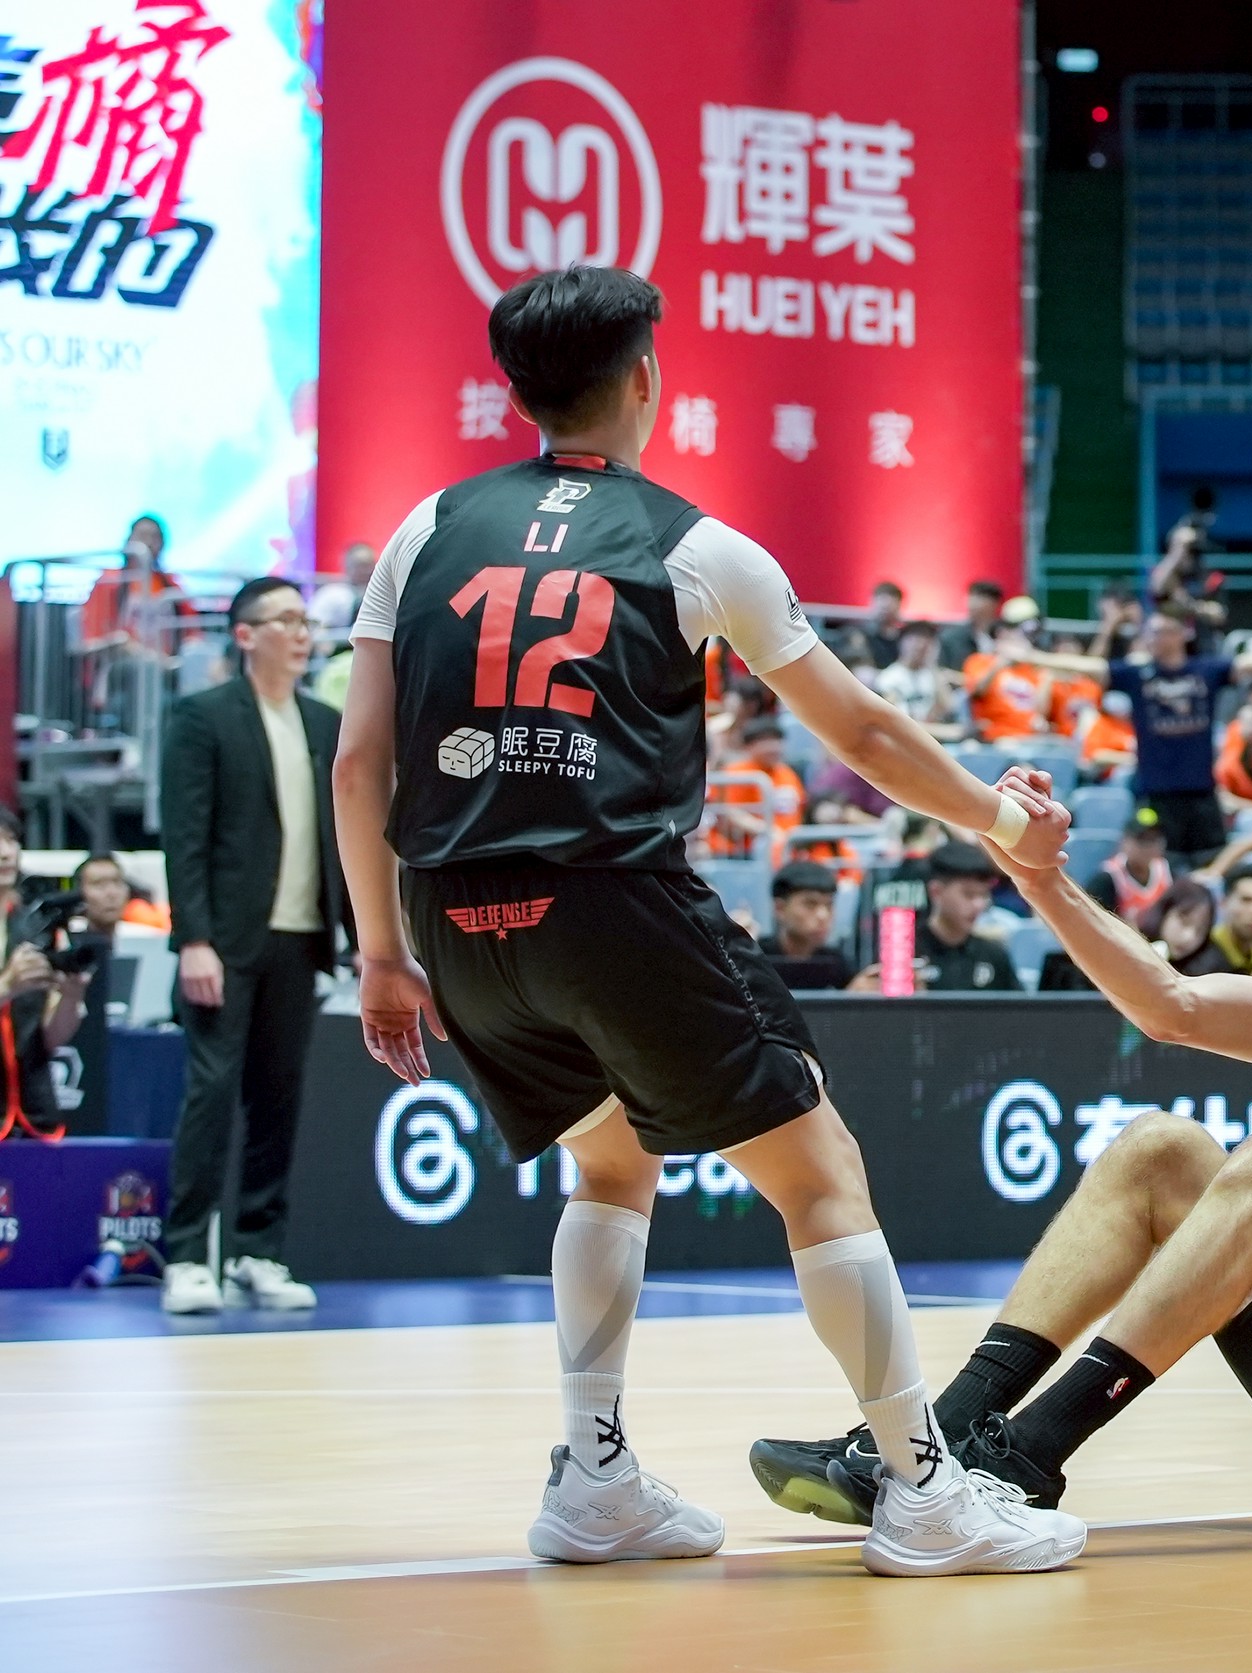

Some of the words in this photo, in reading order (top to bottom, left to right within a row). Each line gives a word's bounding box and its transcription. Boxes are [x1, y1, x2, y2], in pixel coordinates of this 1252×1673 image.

[701, 102, 915, 265] 輝葉
[702, 270, 815, 339] HUEI
[818, 282, 915, 347] YEH
[524, 521, 569, 553] LI
[449, 566, 615, 718] 12
[501, 726, 598, 765] 眠豆腐
[498, 759, 551, 774] SLEEPY
[557, 763, 596, 780] TOFU
[468, 902, 531, 926] DEFENSE
[99, 1216, 162, 1241] PILOTS
